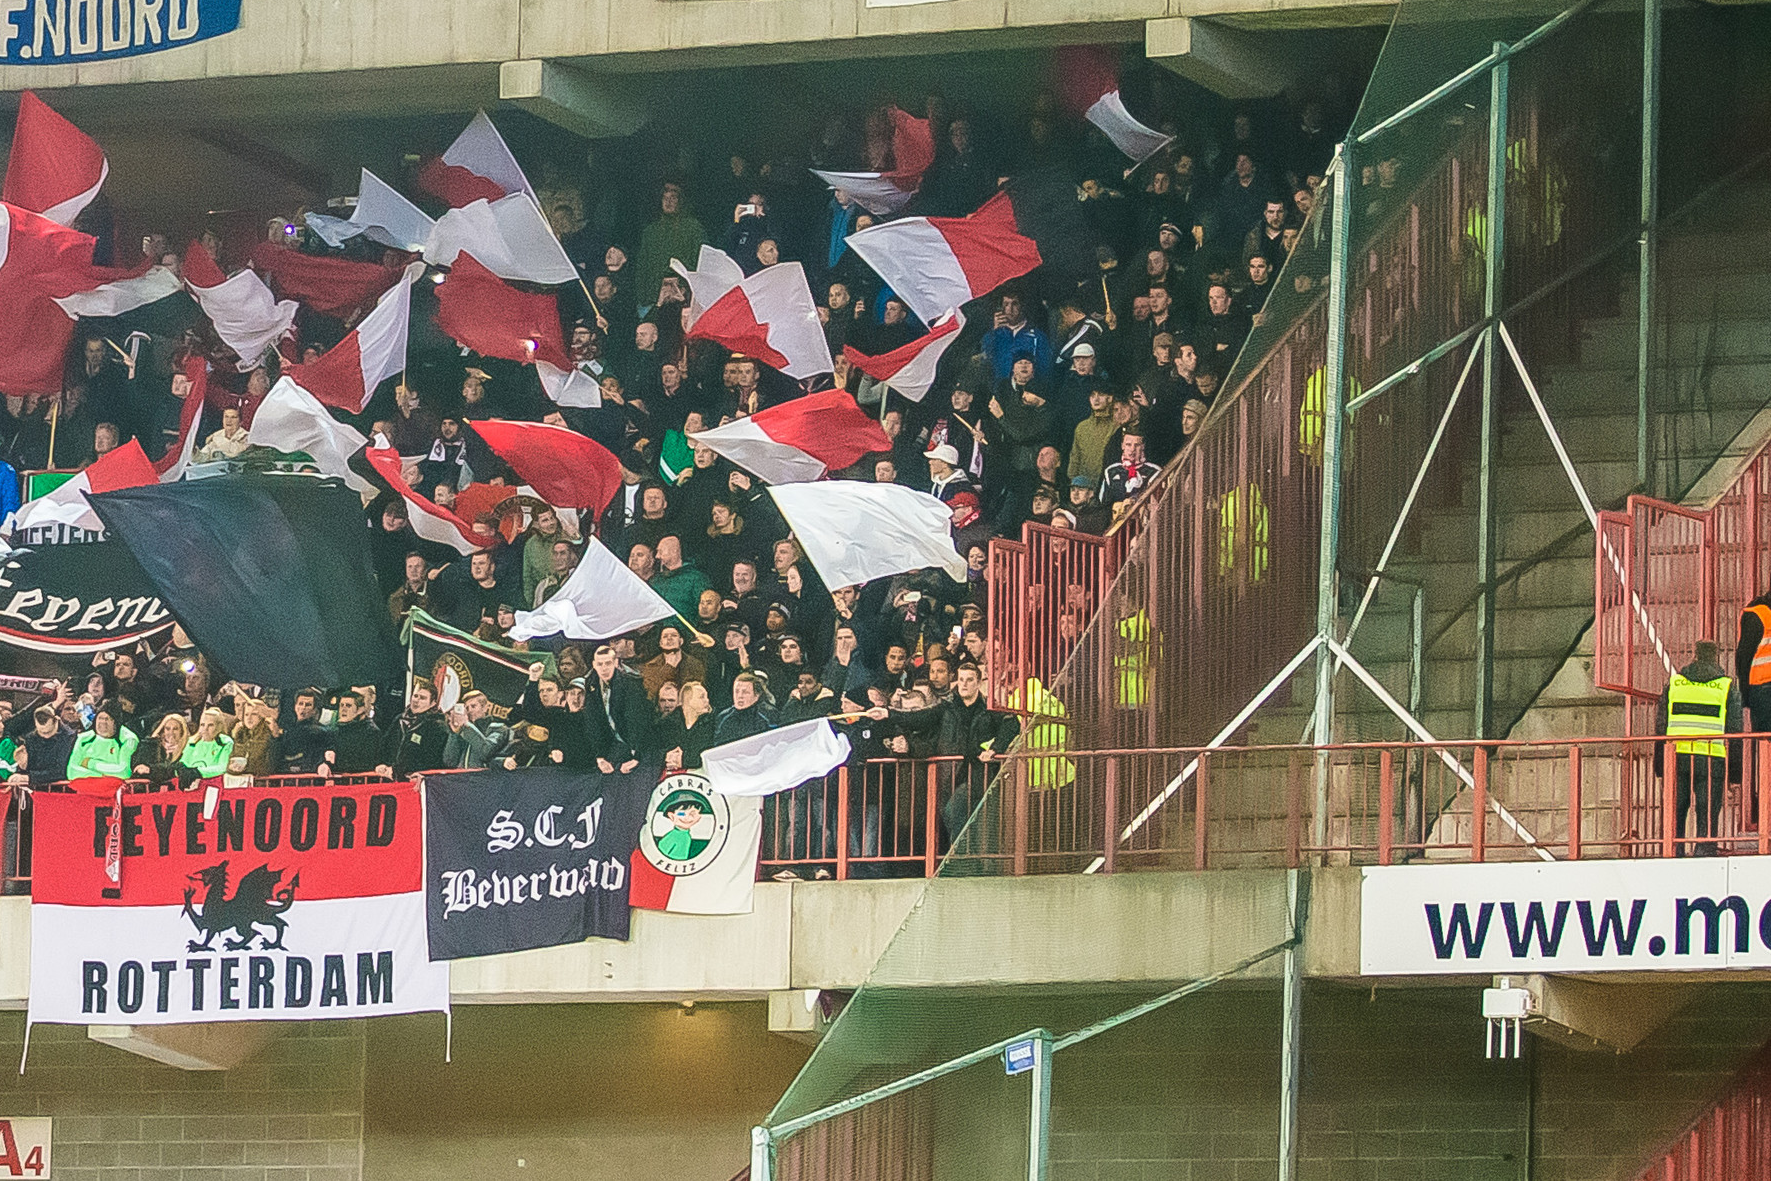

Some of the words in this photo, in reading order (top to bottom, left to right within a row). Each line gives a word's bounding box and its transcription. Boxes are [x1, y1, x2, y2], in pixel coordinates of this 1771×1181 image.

[658, 777, 714, 798] CABRAS
[93, 794, 398, 859] FEYENOORD
[655, 859, 698, 874] FELIZ
[81, 950, 394, 1015] ROTTERDAM
